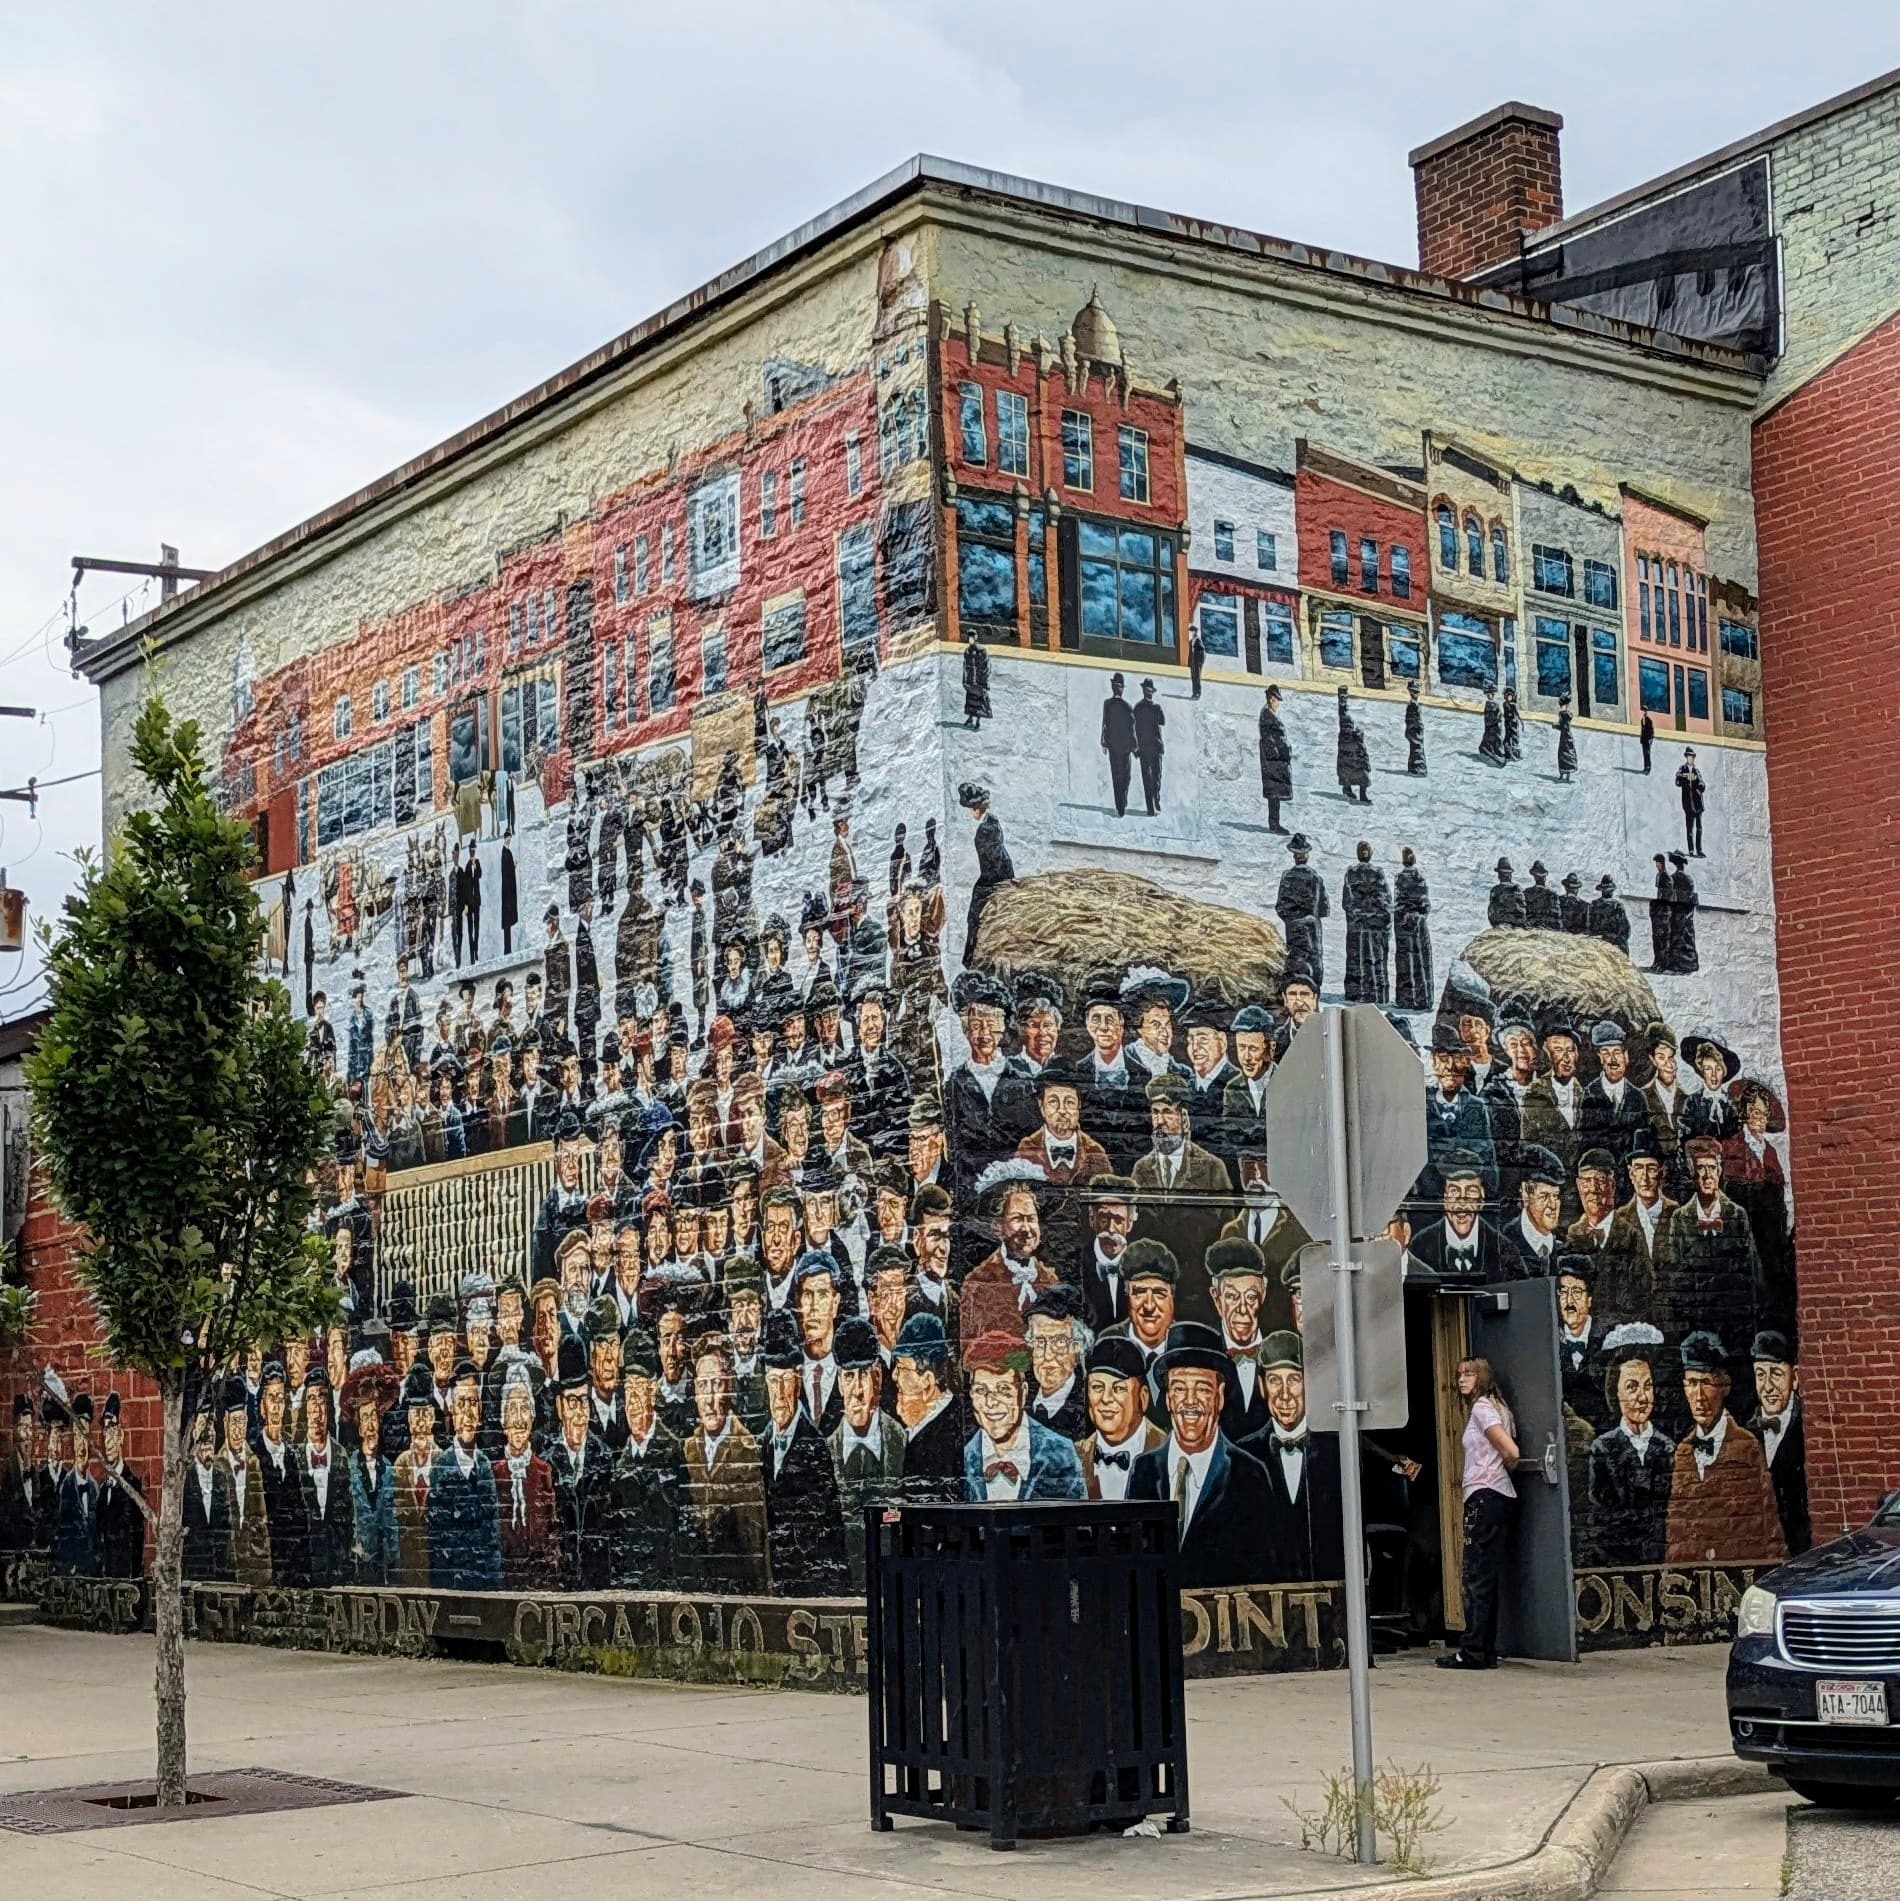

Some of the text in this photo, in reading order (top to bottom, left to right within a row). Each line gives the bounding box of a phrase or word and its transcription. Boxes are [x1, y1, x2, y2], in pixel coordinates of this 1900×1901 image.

[323, 1593, 439, 1646] AIRDAY
[513, 1601, 635, 1662] CIRCA
[1576, 1569, 1755, 1631] ONSIN
[1822, 1694, 1884, 1714] ATA-7044
